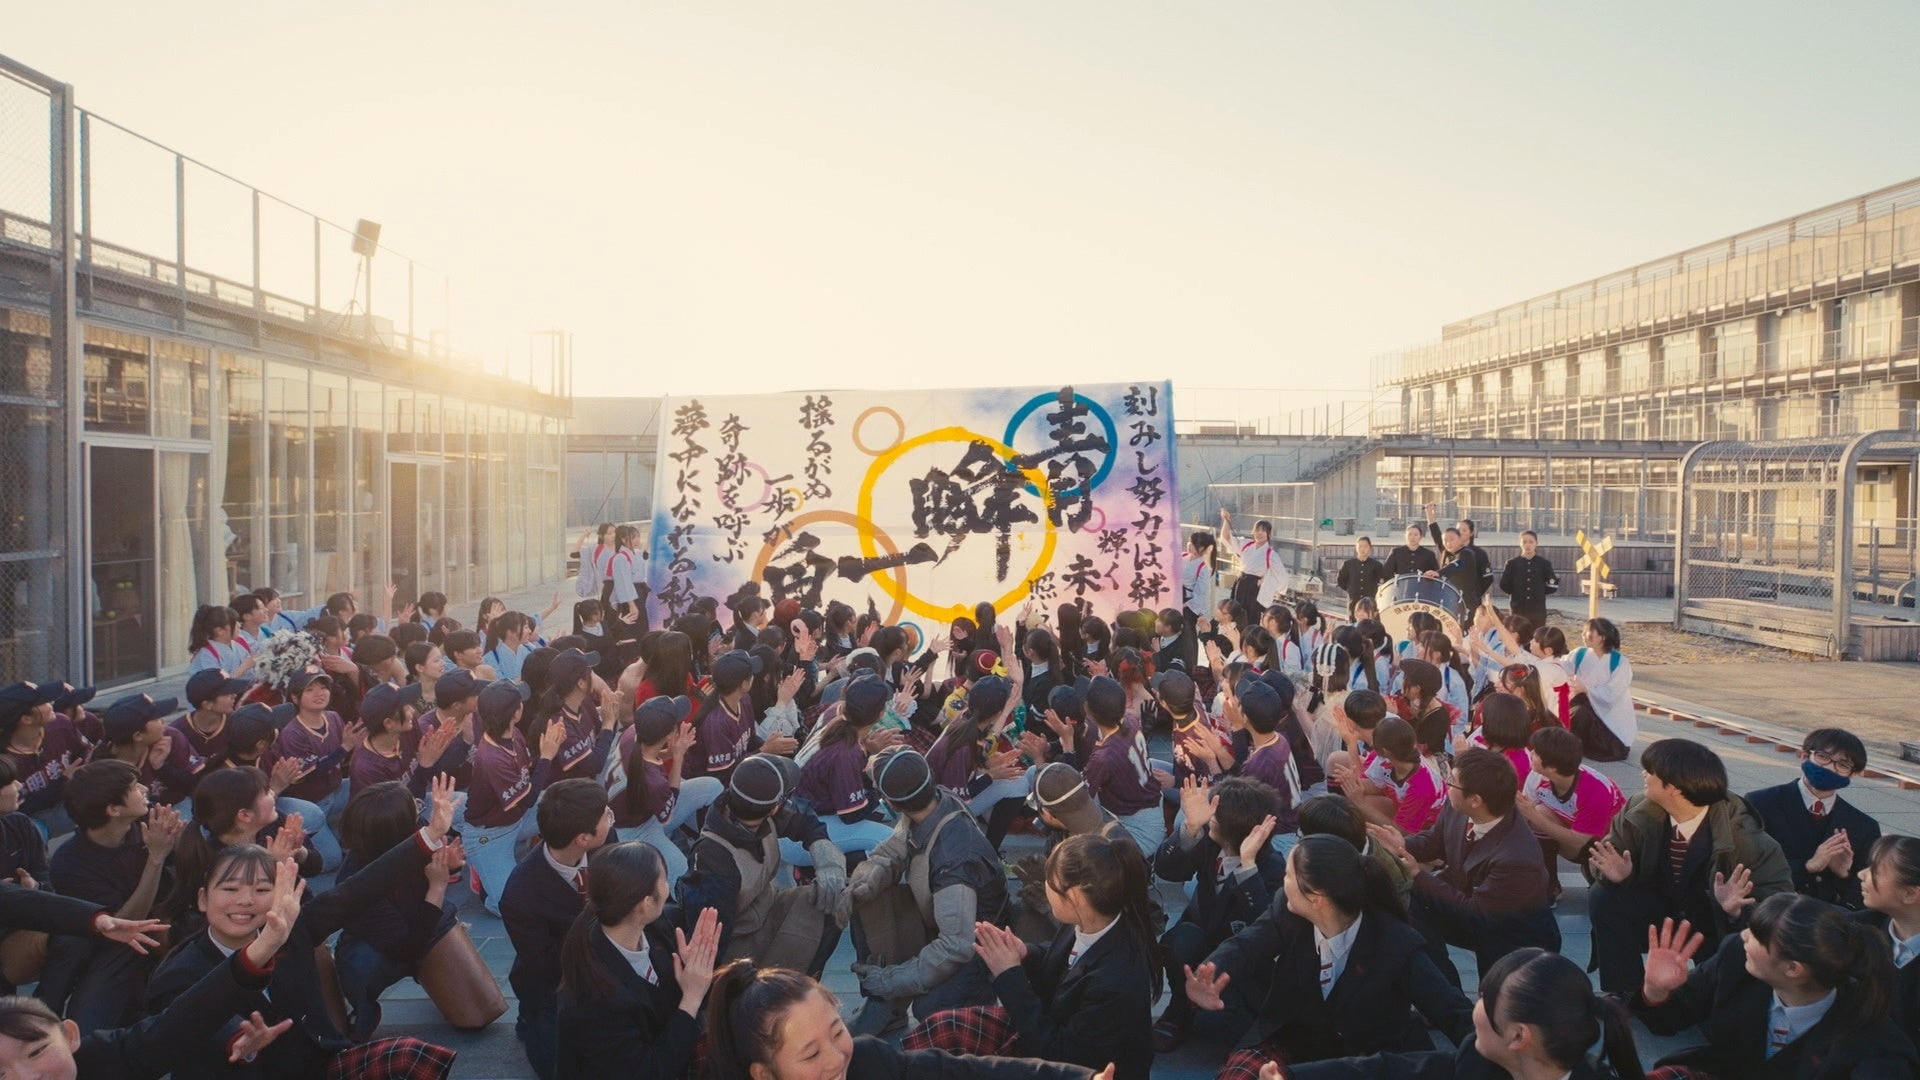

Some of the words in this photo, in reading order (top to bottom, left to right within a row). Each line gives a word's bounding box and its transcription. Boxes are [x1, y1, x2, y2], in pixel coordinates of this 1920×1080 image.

[713, 413, 752, 564] 奇跡を呼ぶ
[761, 474, 796, 547] 一歩が
[1122, 386, 1170, 608] 刻みし努力は絆
[1097, 528, 1130, 591] 輝く
